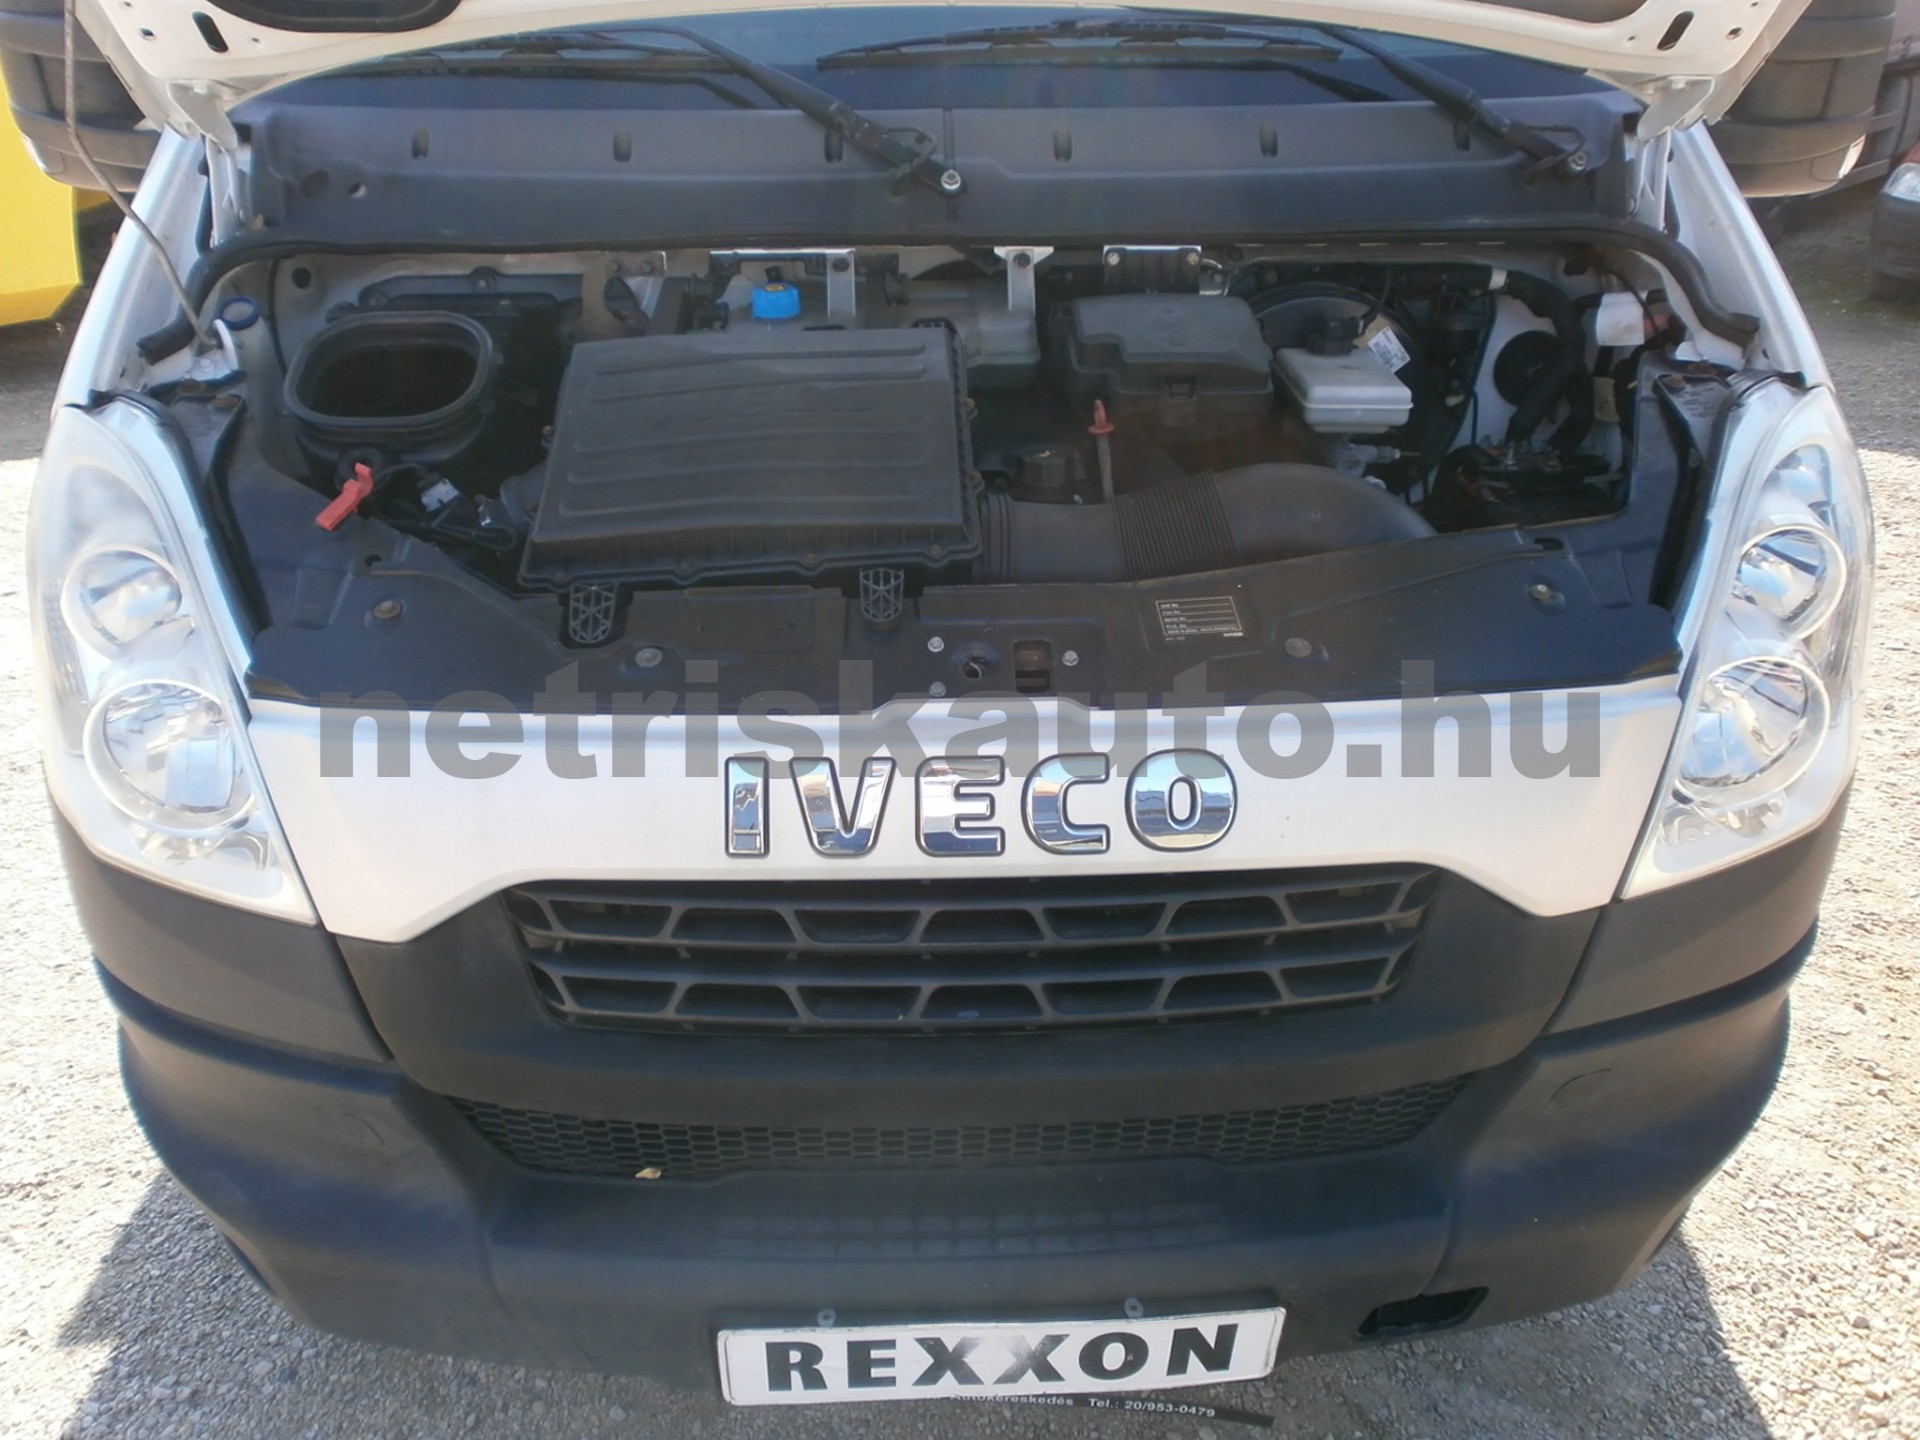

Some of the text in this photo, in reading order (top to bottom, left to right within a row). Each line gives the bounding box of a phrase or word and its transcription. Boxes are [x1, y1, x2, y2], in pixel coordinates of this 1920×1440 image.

[724, 748, 1238, 858] IVECO
[765, 1323, 1239, 1392] REXXON
[1124, 1400, 1216, 1418] 20/953-0479
